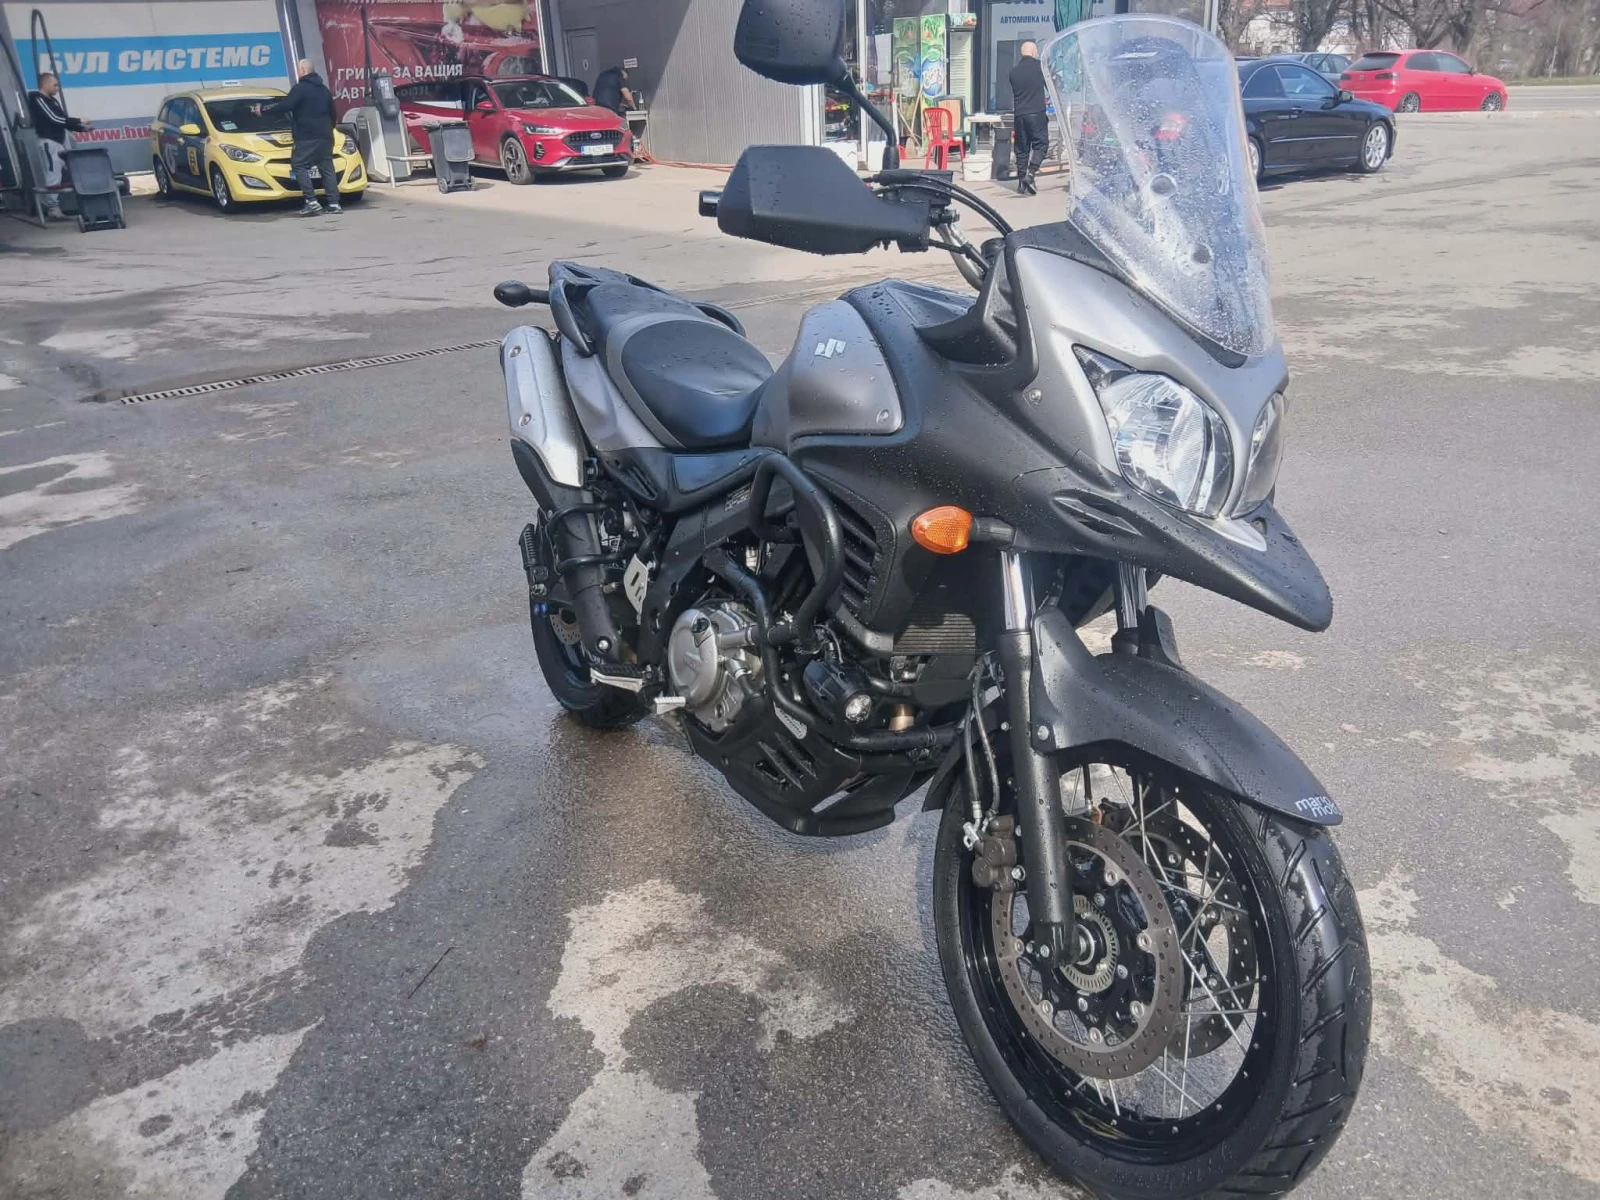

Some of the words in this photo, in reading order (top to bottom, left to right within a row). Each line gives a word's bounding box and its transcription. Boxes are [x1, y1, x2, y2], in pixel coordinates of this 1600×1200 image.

[1041, 15, 1050, 23] НА
[39, 51, 110, 75] БУЛ
[117, 45, 271, 72] СИСТЕМС
[393, 65, 411, 78] ЗА
